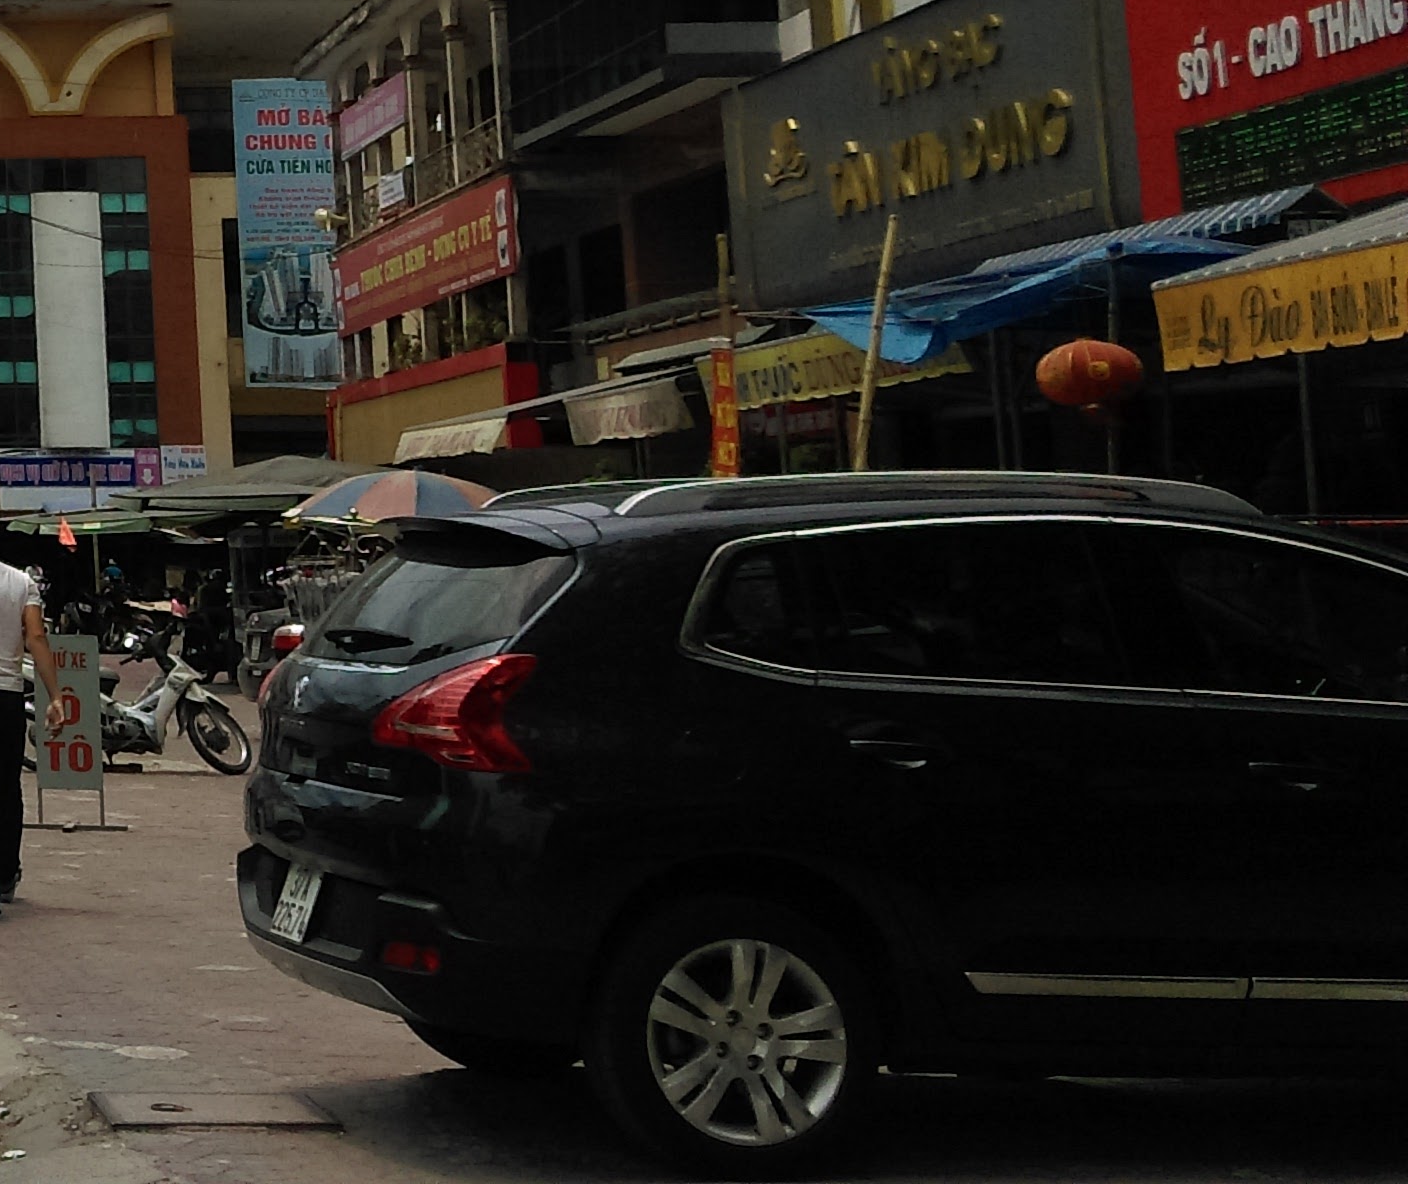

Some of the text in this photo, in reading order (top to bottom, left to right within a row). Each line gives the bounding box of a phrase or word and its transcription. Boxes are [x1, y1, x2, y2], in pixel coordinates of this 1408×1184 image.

[1247, 16, 1299, 78] CAO
[257, 103, 290, 126] MỞ
[246, 134, 316, 150] CHUNG
[891, 131, 951, 198] KIM
[958, 87, 1073, 180] DUNG
[246, 154, 274, 174] CỬA
[1241, 285, 1301, 347] Đào
[71, 653, 87, 668] XE
[62, 687, 80, 725] Ô
[44, 735, 93, 772] TÔ
